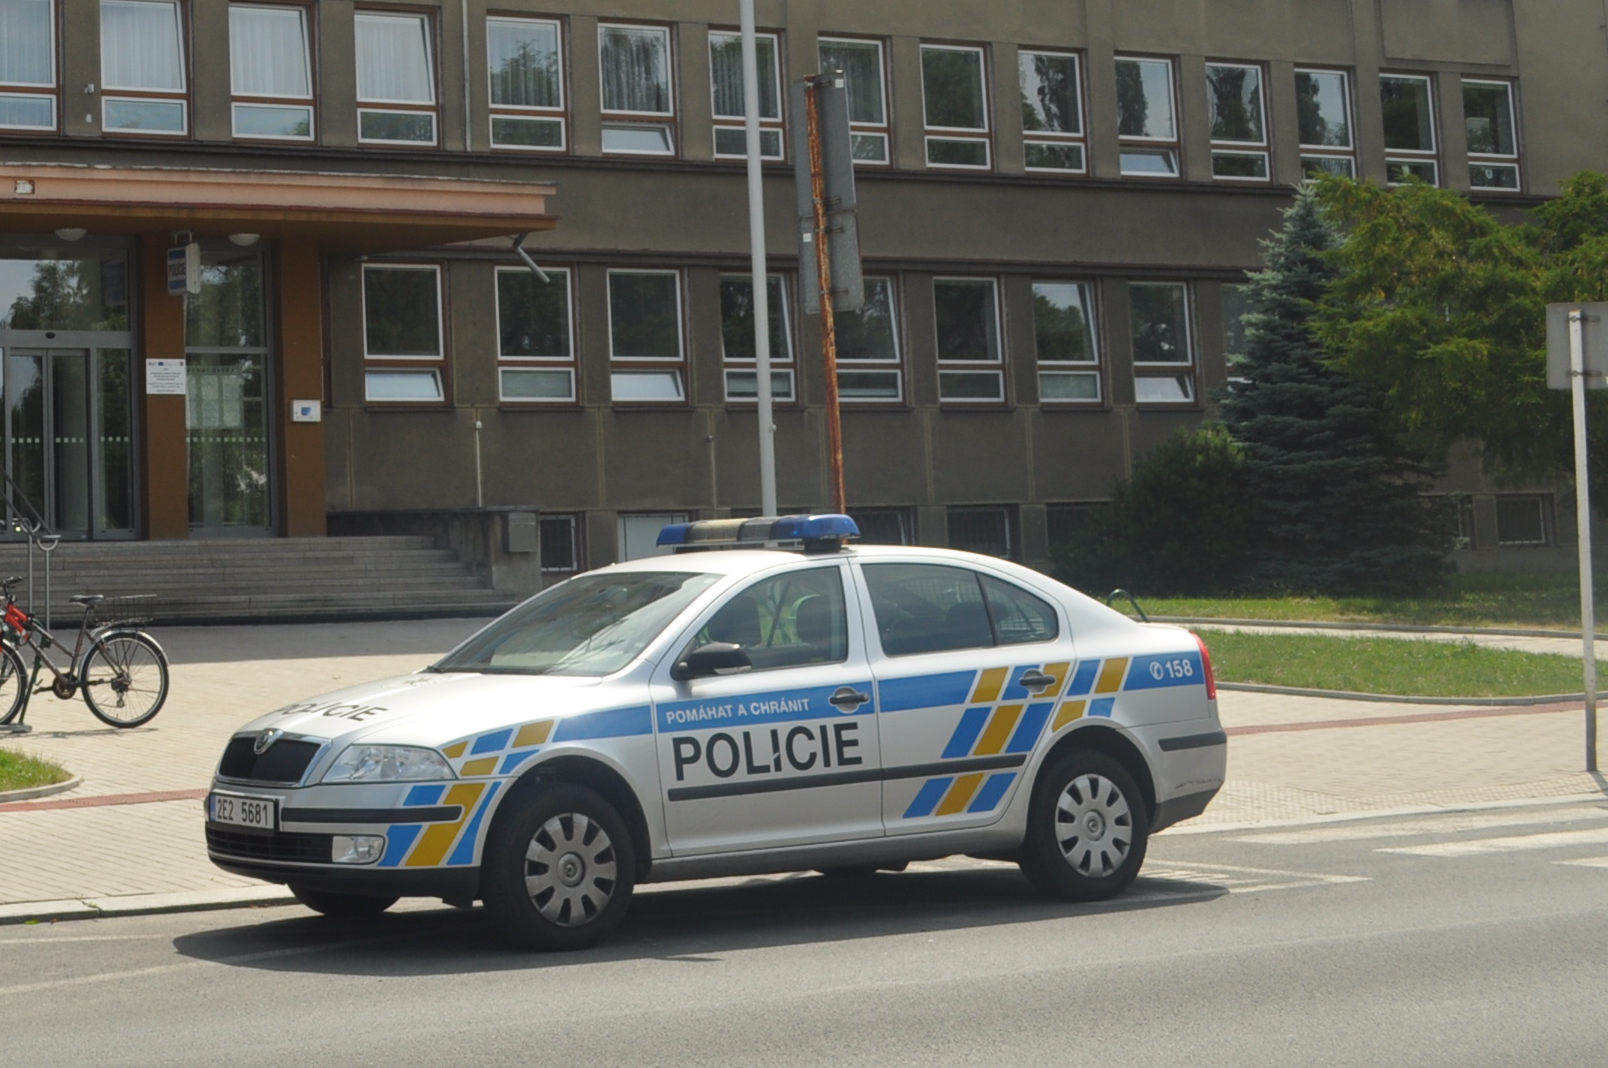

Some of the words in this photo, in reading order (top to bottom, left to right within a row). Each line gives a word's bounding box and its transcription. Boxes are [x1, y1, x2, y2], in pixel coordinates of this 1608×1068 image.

[1165, 659, 1194, 679] 158
[666, 705, 733, 724] POMÁHAT
[737, 704, 748, 717] A
[750, 698, 810, 716] CHRÁNIT
[672, 722, 863, 781] POLICIE
[217, 799, 234, 821] 2E2
[241, 801, 269, 826] 5681
